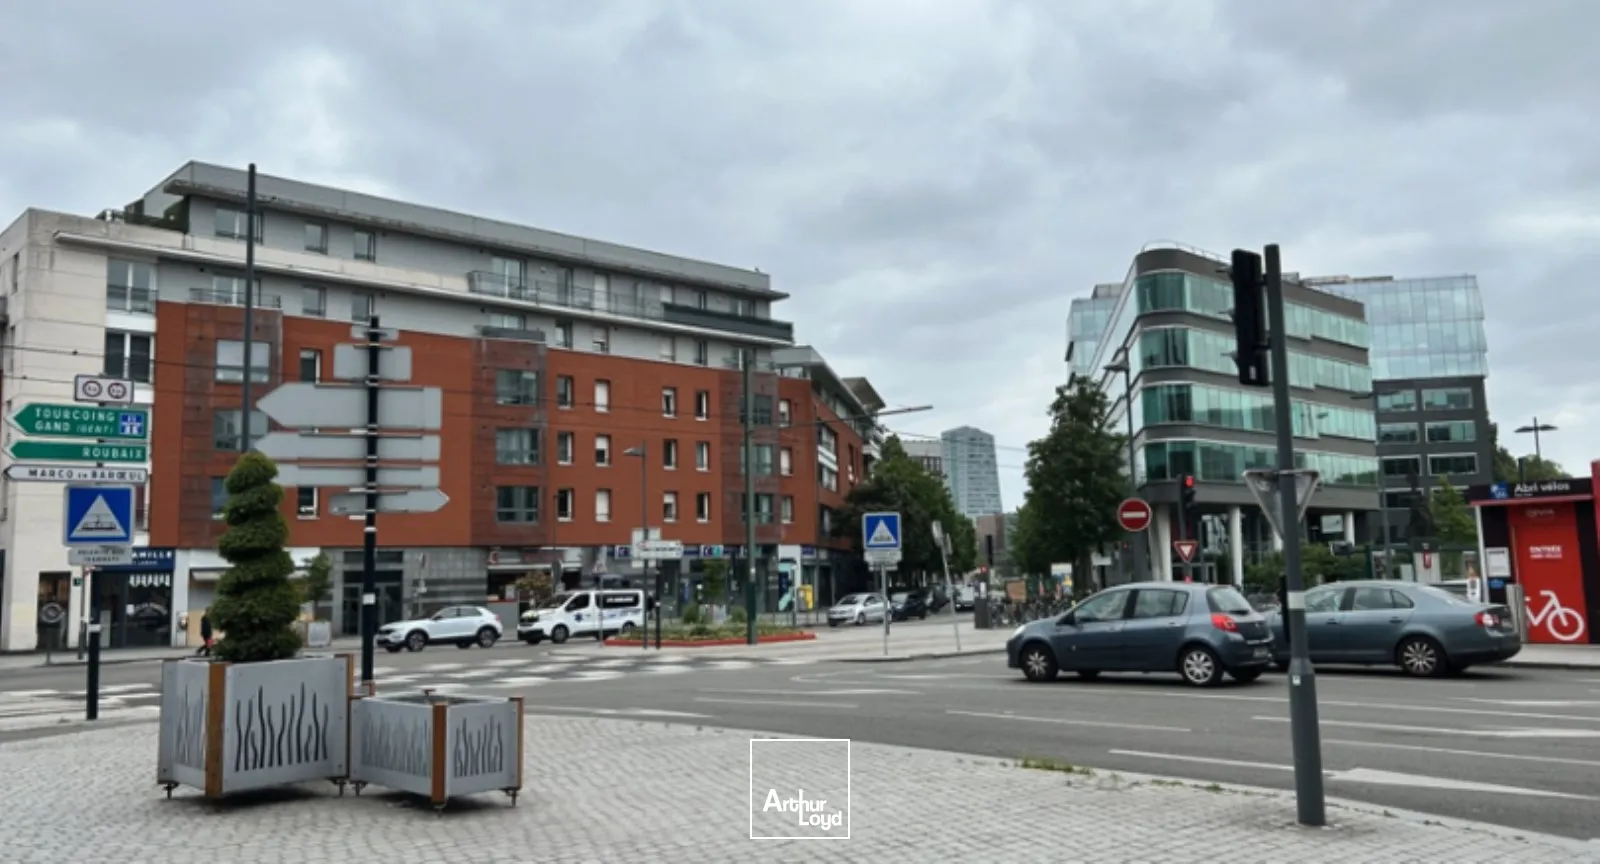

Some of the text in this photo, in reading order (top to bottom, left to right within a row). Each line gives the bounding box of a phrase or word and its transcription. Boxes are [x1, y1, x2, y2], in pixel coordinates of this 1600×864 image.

[35, 407, 115, 422] TOURCOING
[34, 420, 70, 432] GAND
[82, 447, 143, 459] ROUBAIX
